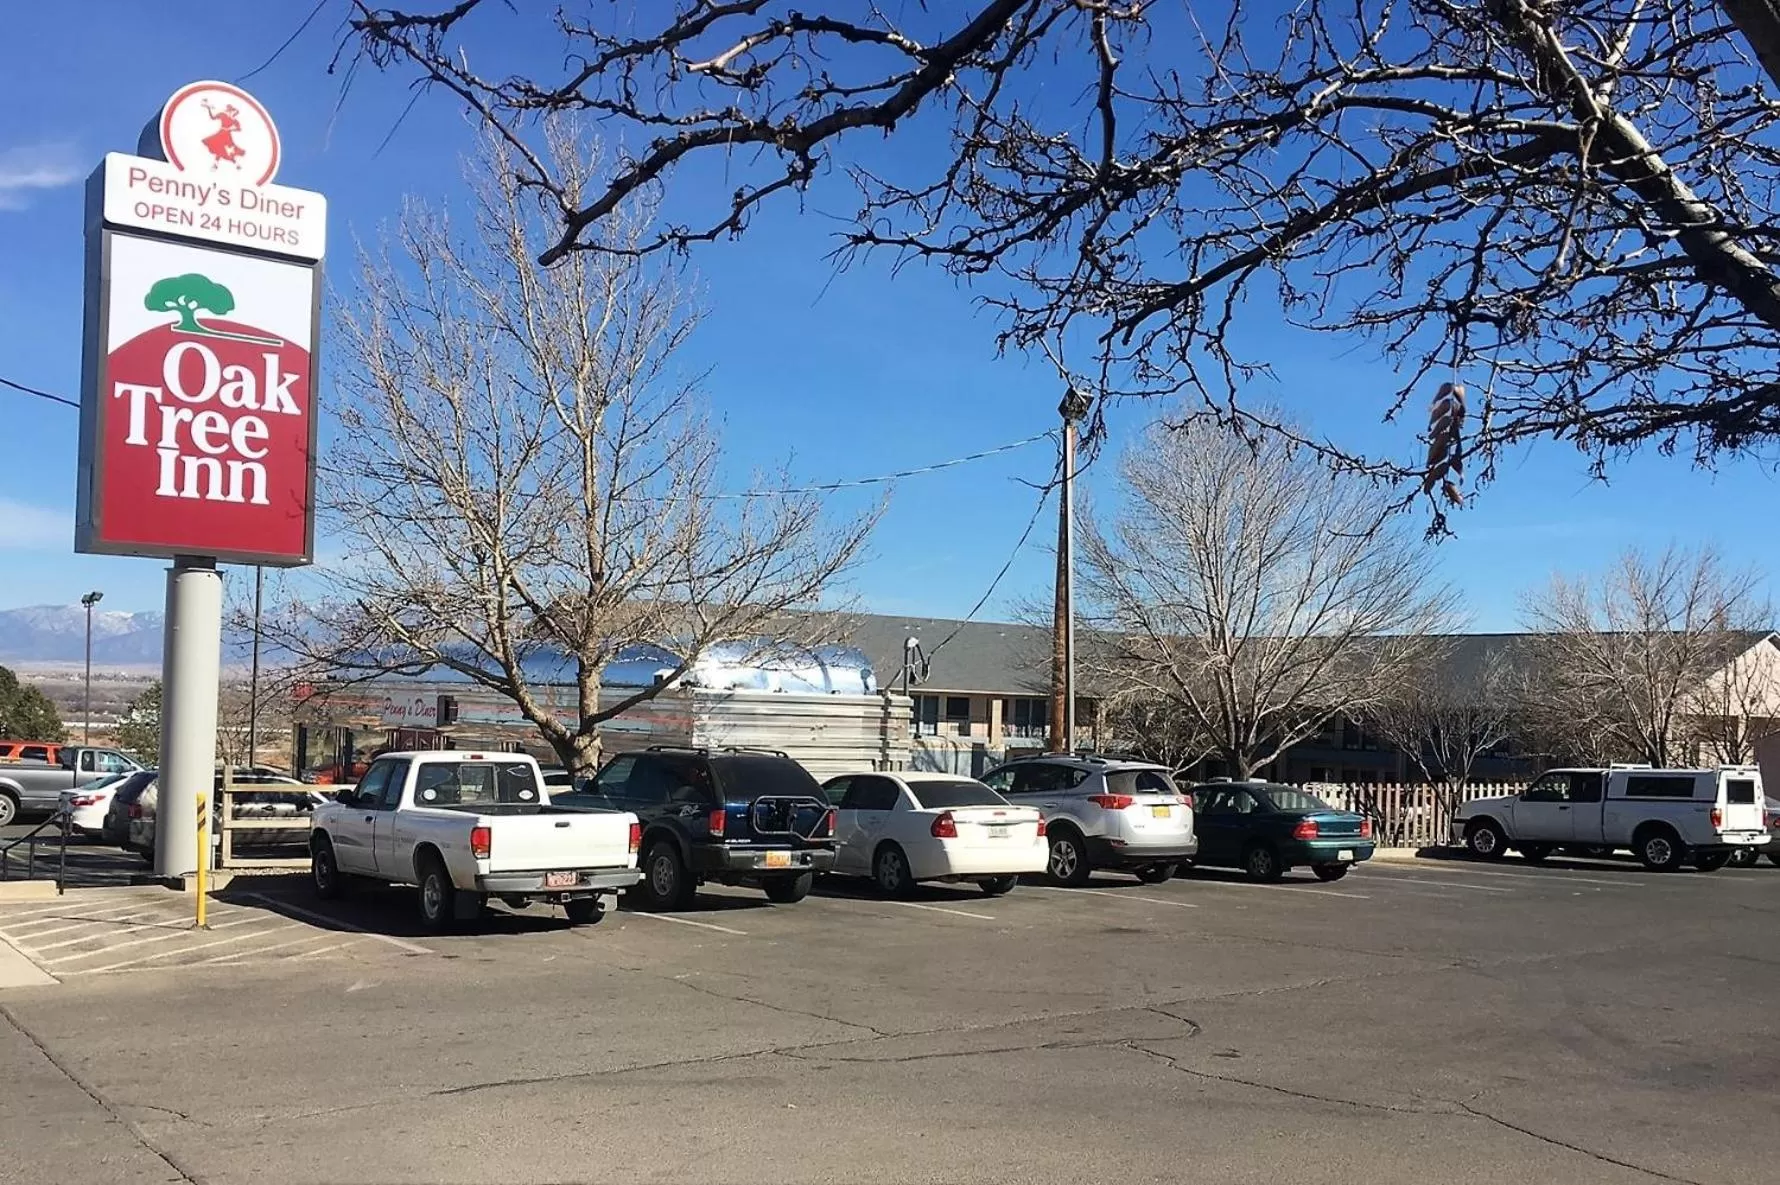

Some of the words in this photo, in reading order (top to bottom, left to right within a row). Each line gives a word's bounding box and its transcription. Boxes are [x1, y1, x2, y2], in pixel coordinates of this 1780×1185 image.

[129, 166, 231, 206] Penny's
[240, 188, 304, 219] Diner
[134, 202, 194, 226] OPEN
[200, 213, 222, 231] 24
[228, 218, 299, 246] HOURS
[162, 341, 301, 415] Oak
[114, 381, 269, 459] Tree
[155, 447, 270, 505] Inn
